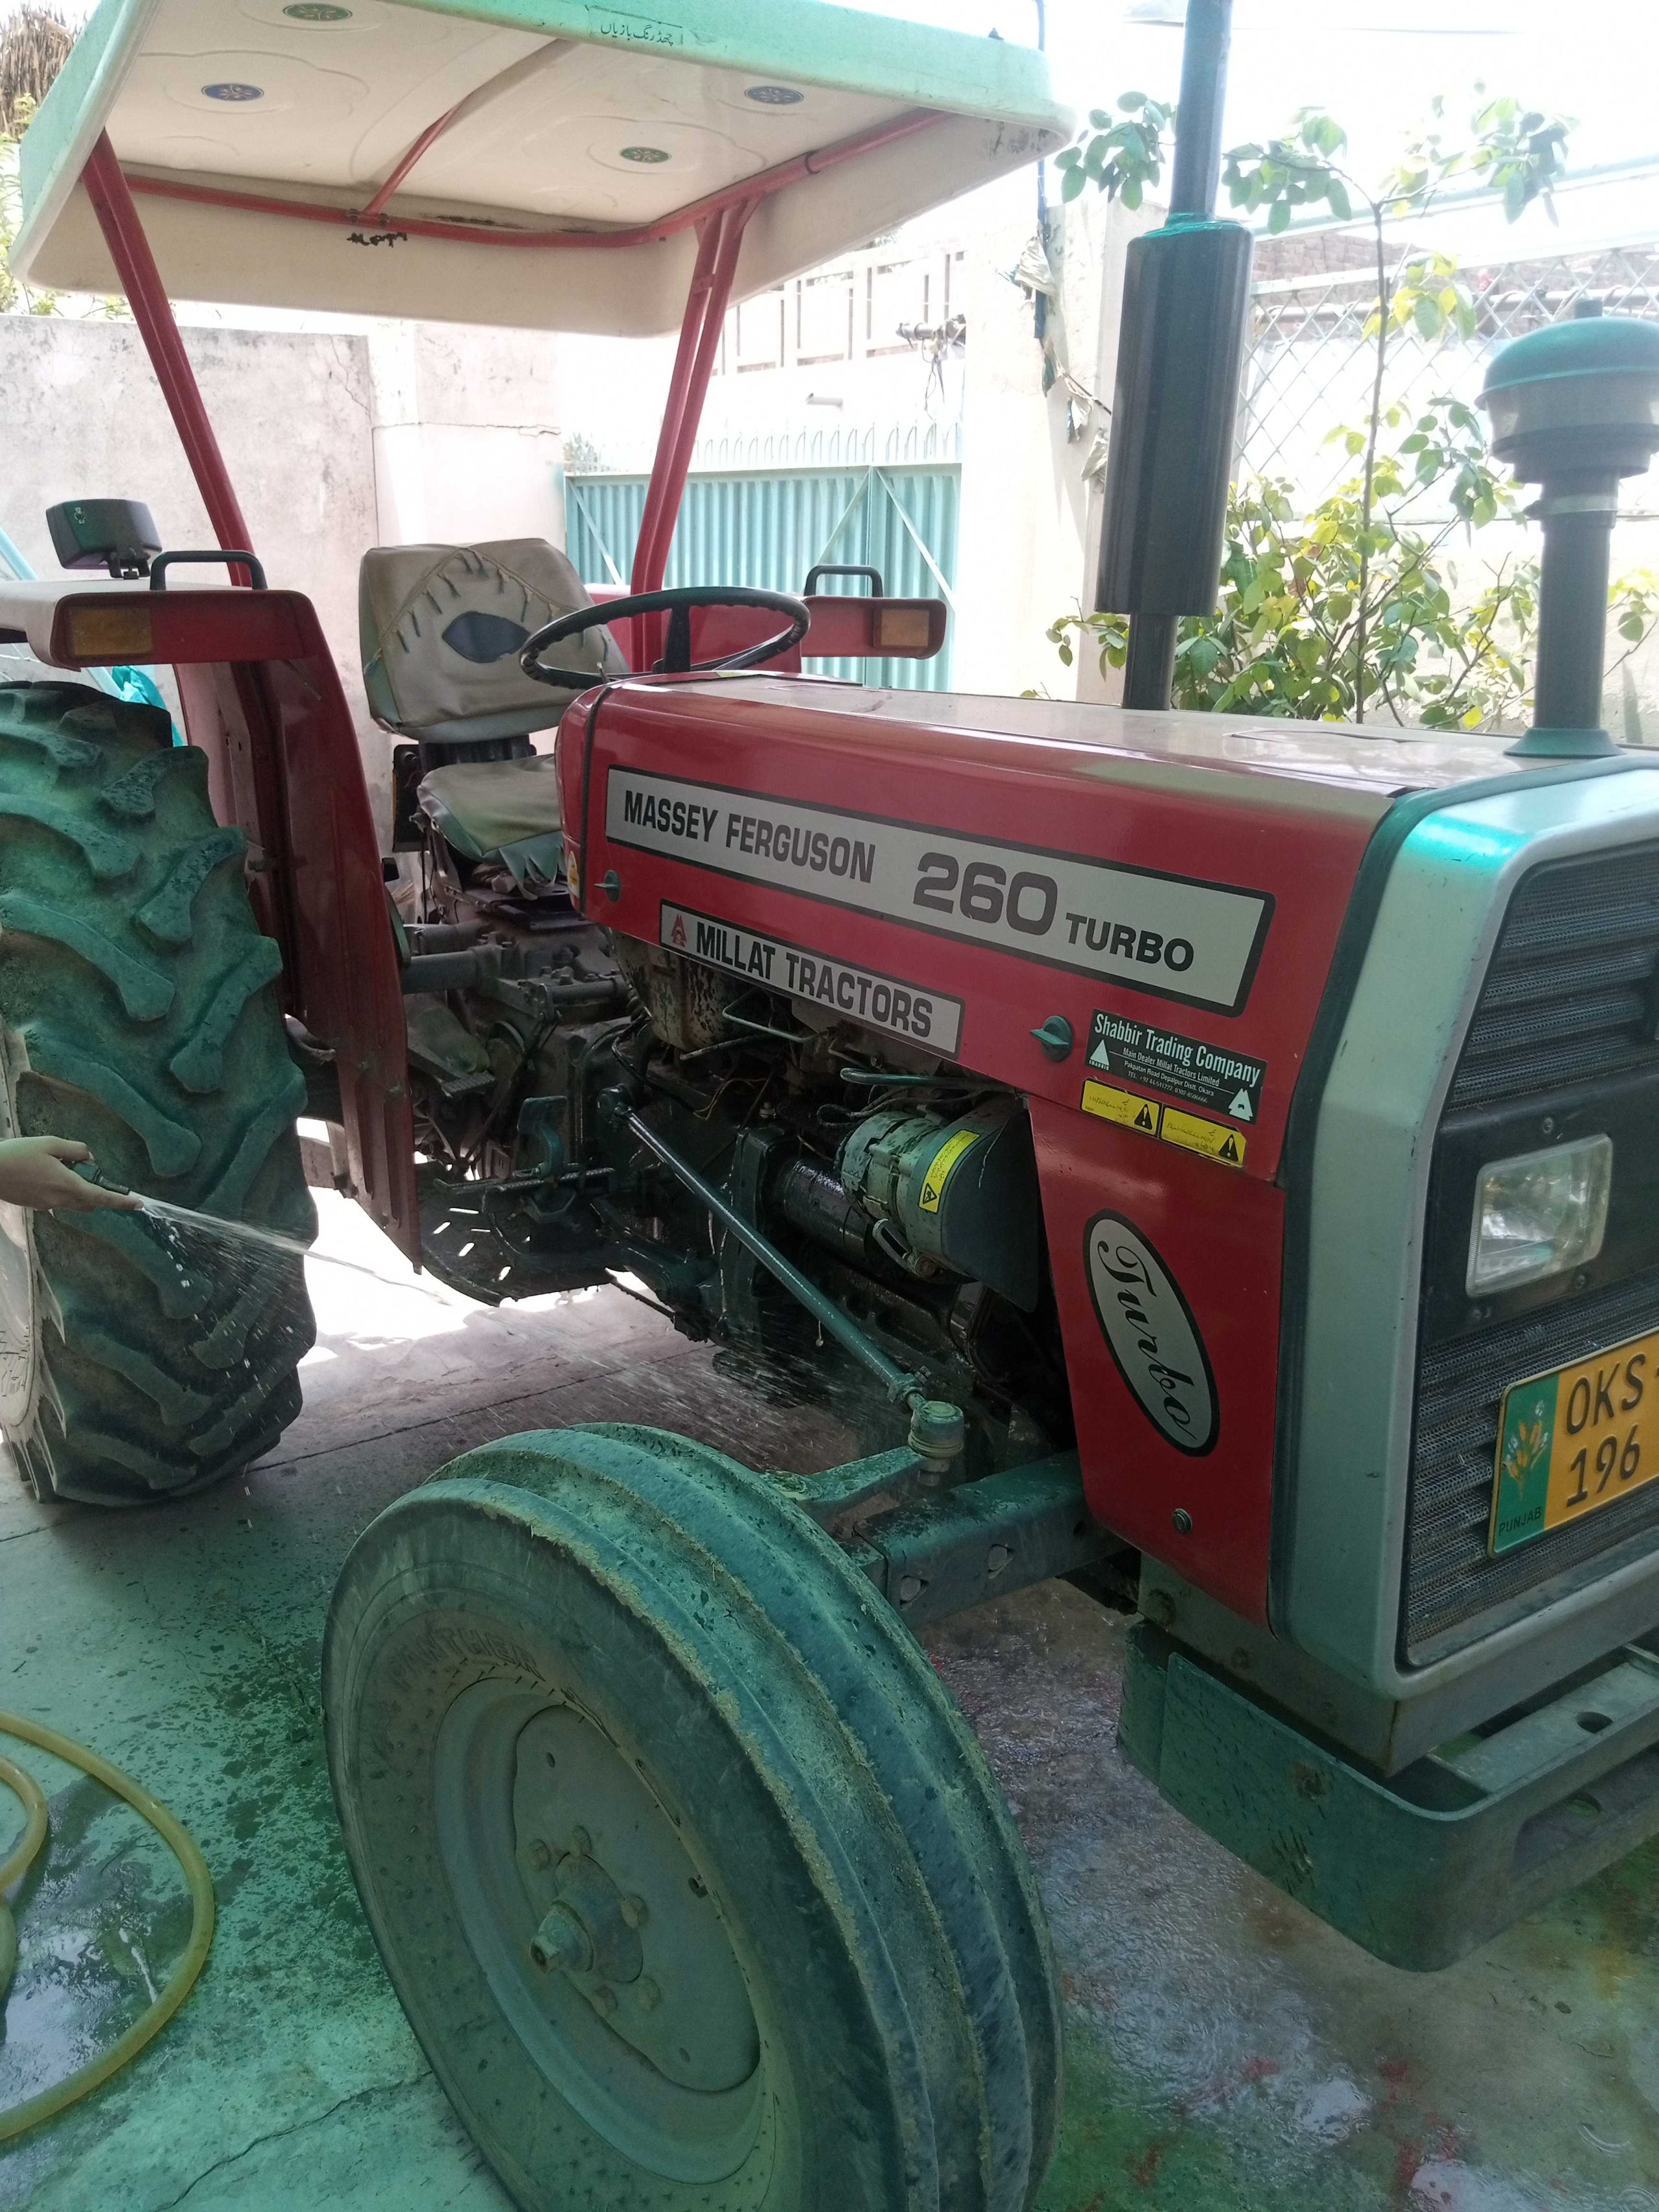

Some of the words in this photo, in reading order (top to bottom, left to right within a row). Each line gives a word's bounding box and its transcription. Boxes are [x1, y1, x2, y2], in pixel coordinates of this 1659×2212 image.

[624, 790, 718, 842] MASSEY
[726, 813, 876, 883] FERGUSON
[913, 852, 1058, 936] 260
[1065, 913, 1194, 972] TURBO
[697, 922, 776, 980] MILLAT
[786, 953, 933, 1038] TRACTORS
[1095, 1014, 1143, 1045] Shabbir
[1146, 1029, 1193, 1067] Trading
[1196, 1045, 1260, 1088] Company
[1122, 1047, 1136, 1060] Main
[1137, 1053, 1155, 1064] Dealer
[1156, 1058, 1172, 1071] Millat
[1174, 1064, 1196, 1079] Tractors
[1198, 1072, 1220, 1086] Limited
[1124, 1060, 1146, 1073] Pakpatan
[1147, 1068, 1159, 1078] Road
[1161, 1073, 1183, 1086] Depalpur
[1198, 1086, 1214, 1096] Okara
[1097, 1240, 1197, 1440] Turbo
[1566, 1353, 1646, 1435] OKS
[1566, 1424, 1642, 1508] 196
[1498, 1506, 1542, 1537] PUNJAB
